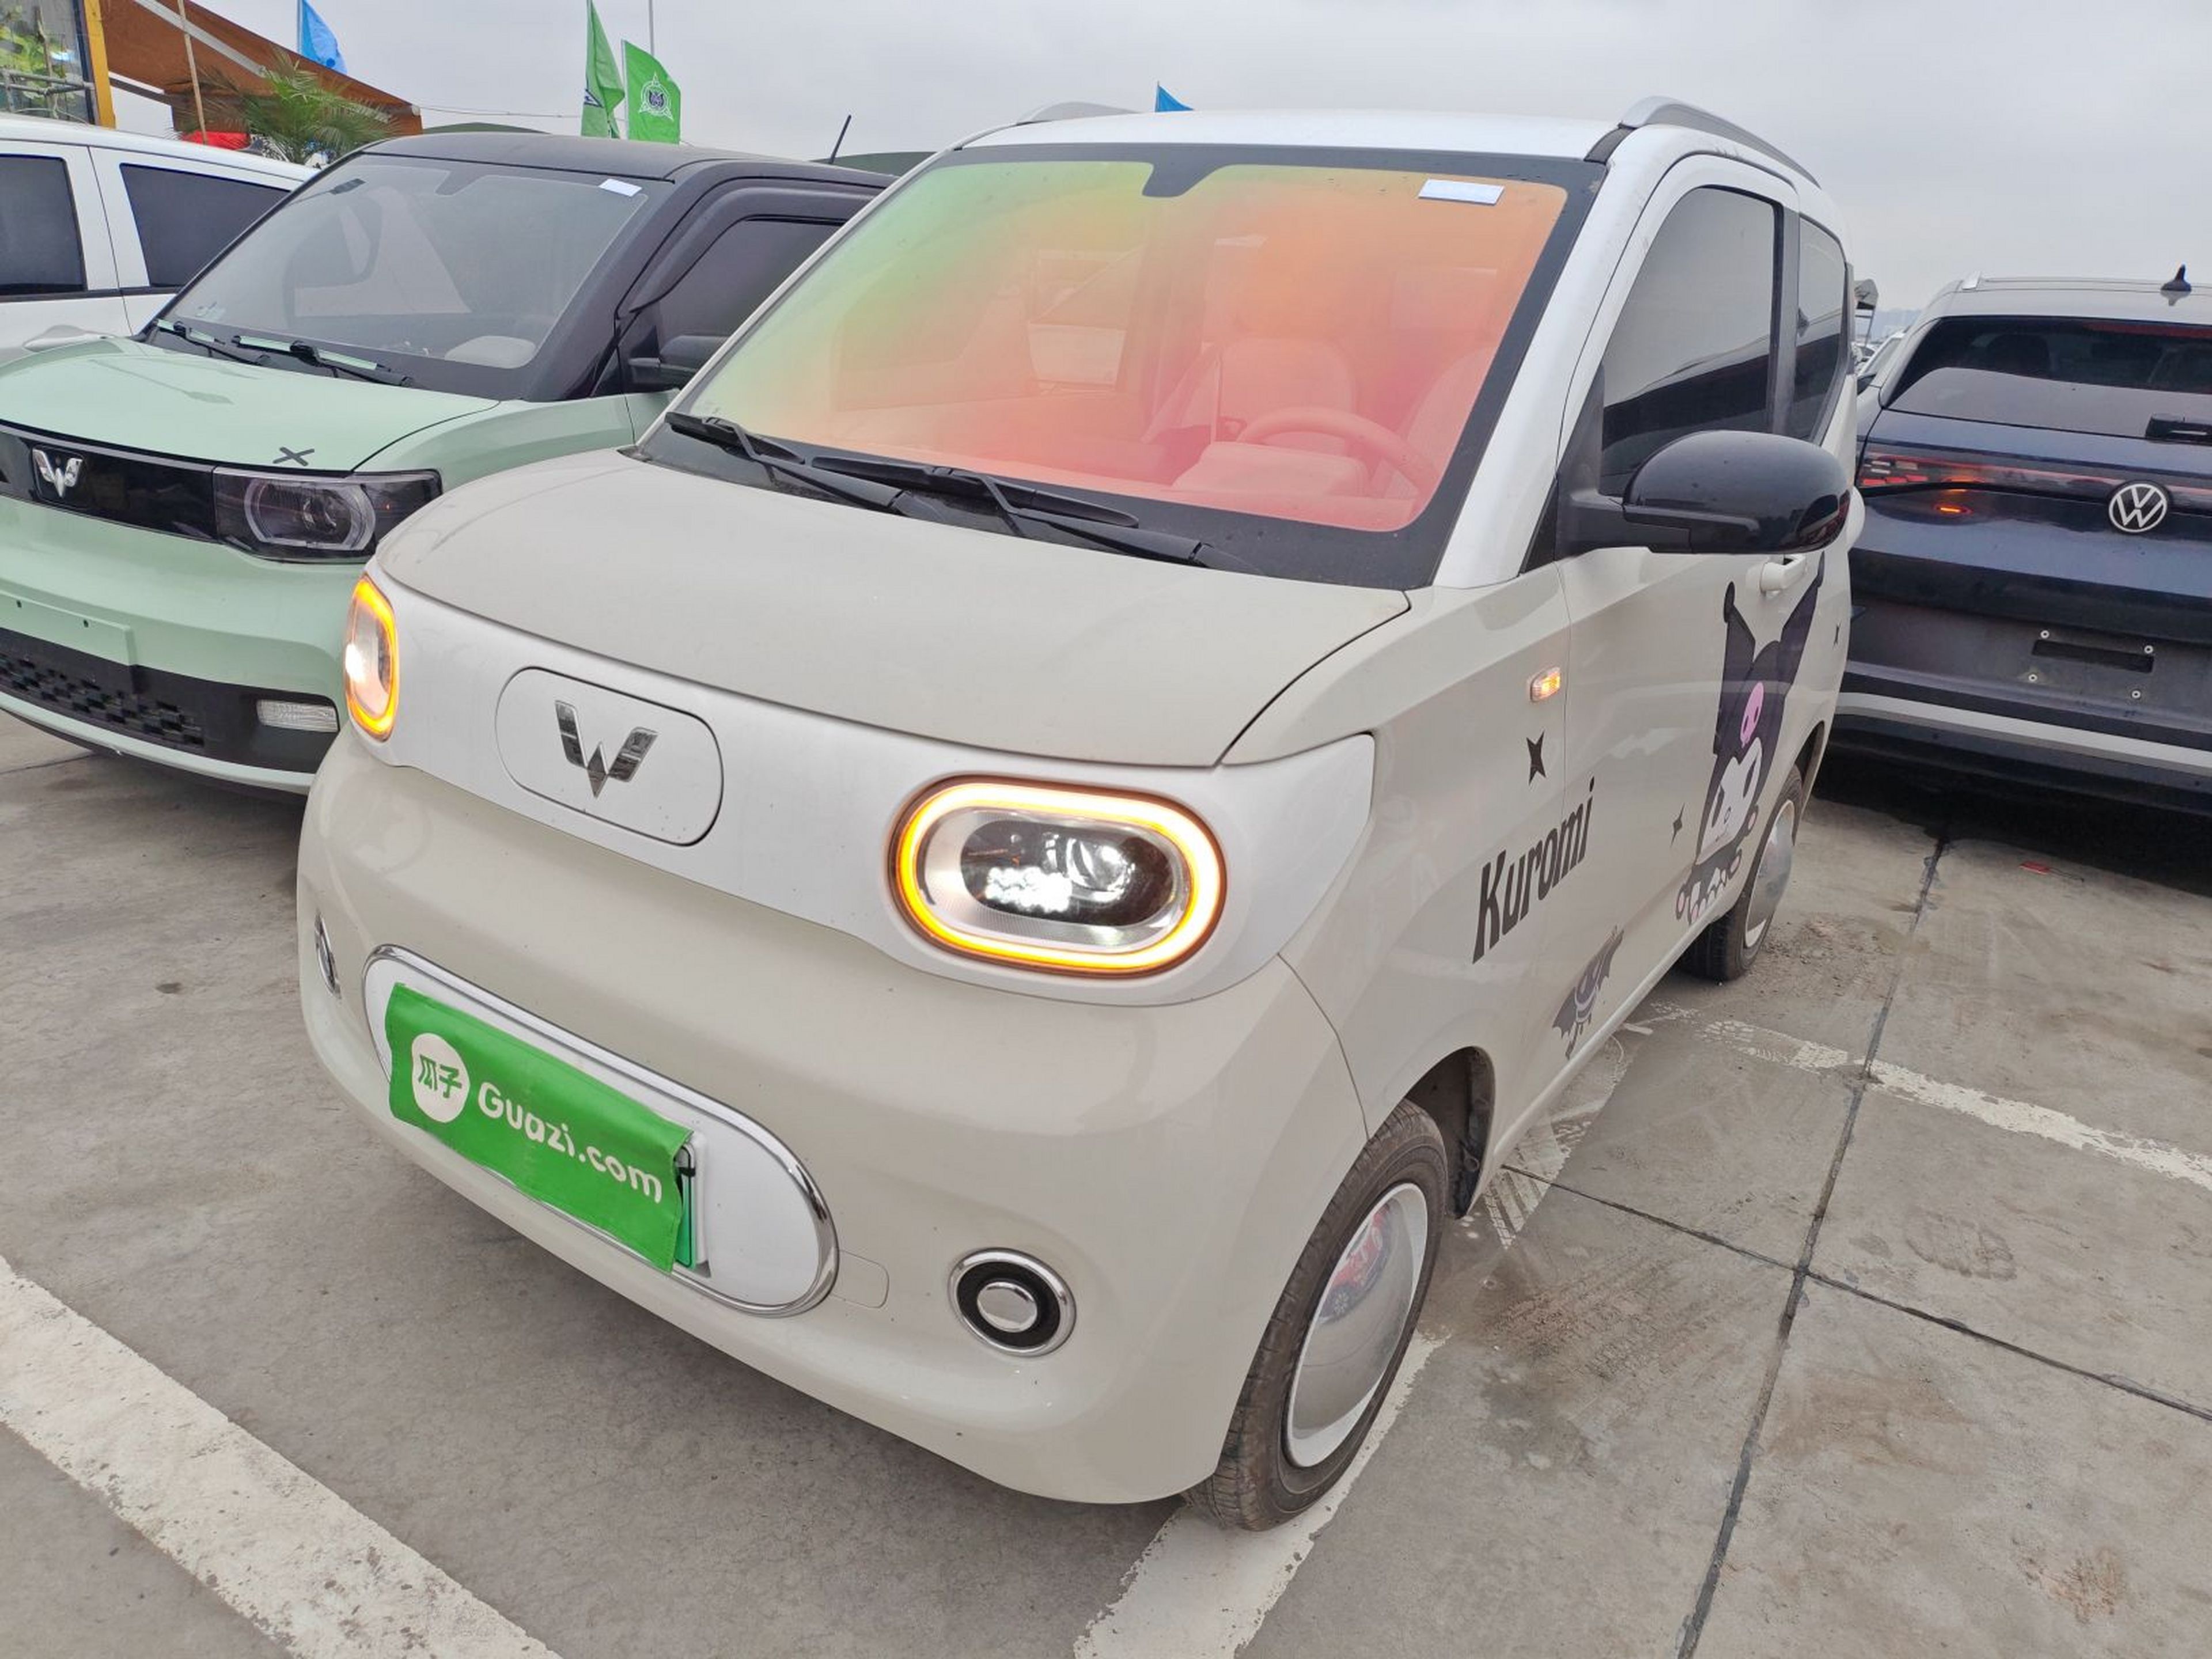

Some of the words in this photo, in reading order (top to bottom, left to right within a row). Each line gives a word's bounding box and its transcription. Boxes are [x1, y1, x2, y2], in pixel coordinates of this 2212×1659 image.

[1473, 775, 1594, 965] Kuromi
[419, 1054, 463, 1099] 瓜子
[478, 1081, 662, 1204] Guazi.com
